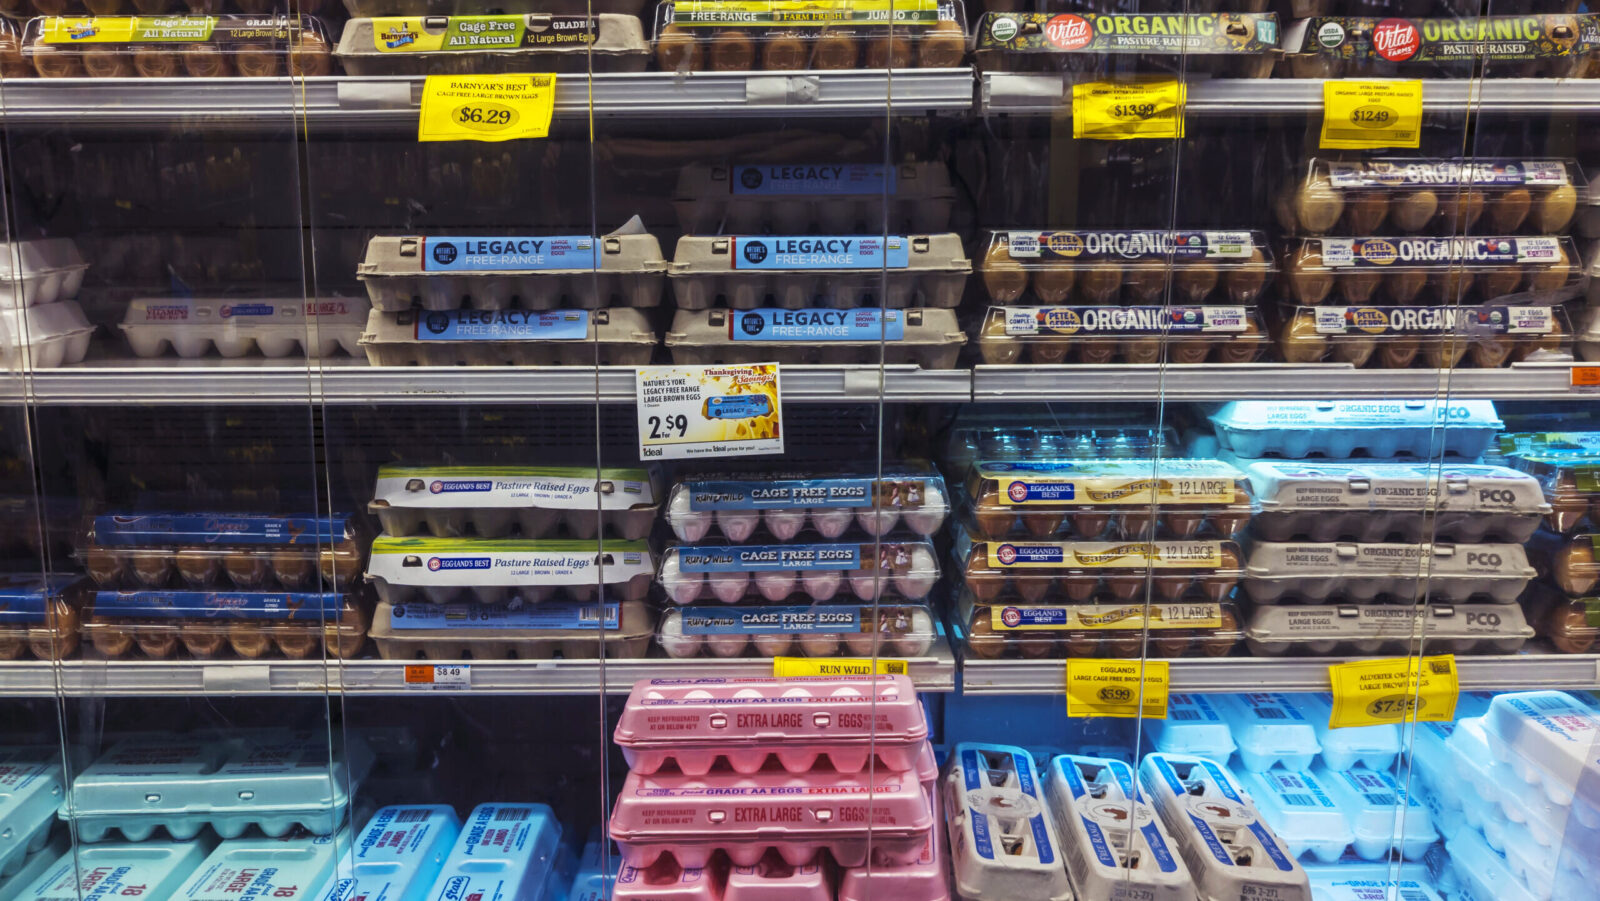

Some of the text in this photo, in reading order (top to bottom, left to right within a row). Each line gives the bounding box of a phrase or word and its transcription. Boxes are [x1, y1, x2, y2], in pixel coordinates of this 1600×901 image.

[691, 12, 757, 21] FREE-RANGE
[783, 12, 809, 20] FARM
[812, 12, 842, 20] FREH
[153, 19, 205, 28] Cage Free
[459, 21, 515, 33] Cage Free
[553, 21, 585, 30] GRADE
[1096, 16, 1214, 36] ORGANIC
[143, 29, 203, 37] All Natural
[1048, 19, 1087, 41] Vital
[1423, 18, 1540, 42] ORGANIC
[1588, 27, 1596, 35] 12
[450, 34, 515, 45] All Natural
[527, 33, 595, 45] 12 Large Brown Egs
[1374, 24, 1413, 50] Vital
[1388, 47, 1412, 57] FARMS
[450, 82, 528, 91] BARNYAR'S BEST
[459, 106, 511, 124] $6.29
[770, 167, 843, 180] LEGACY
[465, 240, 544, 255] LEGACY
[775, 240, 853, 253] LEGACY
[1086, 232, 1177, 255] ORGANIC
[1399, 239, 1488, 261] ORGANIC
[465, 255, 545, 265] FREE-RANGE
[775, 254, 853, 264] FREE-RANGE
[456, 311, 533, 325] LEGACY
[772, 312, 849, 325] LEGACY
[1083, 309, 1173, 331] ORGANIC
[1390, 309, 1478, 331] ORGANIC
[456, 325, 534, 335] FREE-RANGE
[772, 326, 849, 336] FREE-RANGE
[671, 378, 686, 386] YOKE
[737, 373, 775, 385] Savings!
[643, 387, 665, 395] LEGACY
[666, 386, 680, 394] FREE
[644, 393, 701, 403] LARGE BROWN EGGS
[1379, 405, 1401, 413] EGGS
[1437, 406, 1471, 420] PCO
[648, 415, 661, 439] 2
[665, 414, 688, 438] $9
[643, 447, 663, 457] ideal
[495, 481, 590, 494] Pasture Raised Eggs
[751, 486, 865, 498] CAGE FREE EGGS
[1179, 481, 1227, 495] 12 LARGE
[1374, 487, 1416, 497] ORGANIC
[695, 491, 744, 503] RUN WILD
[1296, 495, 1340, 503] LARGE EGGS
[1479, 489, 1516, 503] PCO
[740, 550, 853, 561] CAGE FREE EGGS
[1166, 545, 1215, 560] 12 LARGE
[1286, 554, 1329, 562] LARGE EGGS
[1363, 547, 1404, 558] ORGANIC
[494, 557, 590, 570] Pasture Raised Eggs
[685, 554, 733, 565] RUN WILD
[1467, 552, 1502, 567] PCO
[742, 613, 853, 623] CAGE FREE EGGS
[1168, 606, 1216, 620] 12 LARGE
[1364, 609, 1404, 619] ORGANIC
[687, 617, 735, 627] RUN WILD
[1289, 618, 1332, 626] LARGE EGGS
[1466, 612, 1502, 627] PCO
[437, 666, 448, 676] $8
[449, 667, 461, 676] 49
[820, 665, 871, 675] RUN WILD
[1100, 666, 1136, 674] EGGLANDS
[770, 696, 802, 704] EGGS
[808, 695, 848, 703] EXTRA
[1100, 688, 1131, 702] $5.99
[1373, 698, 1420, 715] $7.99
[737, 713, 769, 728] EXTRA
[771, 713, 803, 728] LARGE
[838, 713, 863, 728] EGGS
[751, 787, 767, 795] AA
[809, 786, 849, 794] EXTRA
[735, 807, 767, 822] EXTRA
[770, 807, 803, 822] LARGE
[839, 807, 865, 823] EGGS
[493, 828, 510, 847] JUMBO
[81, 866, 113, 892] LARGE
[224, 867, 259, 893] LARGE
[120, 883, 147, 897] 18
[273, 884, 298, 898] 18
